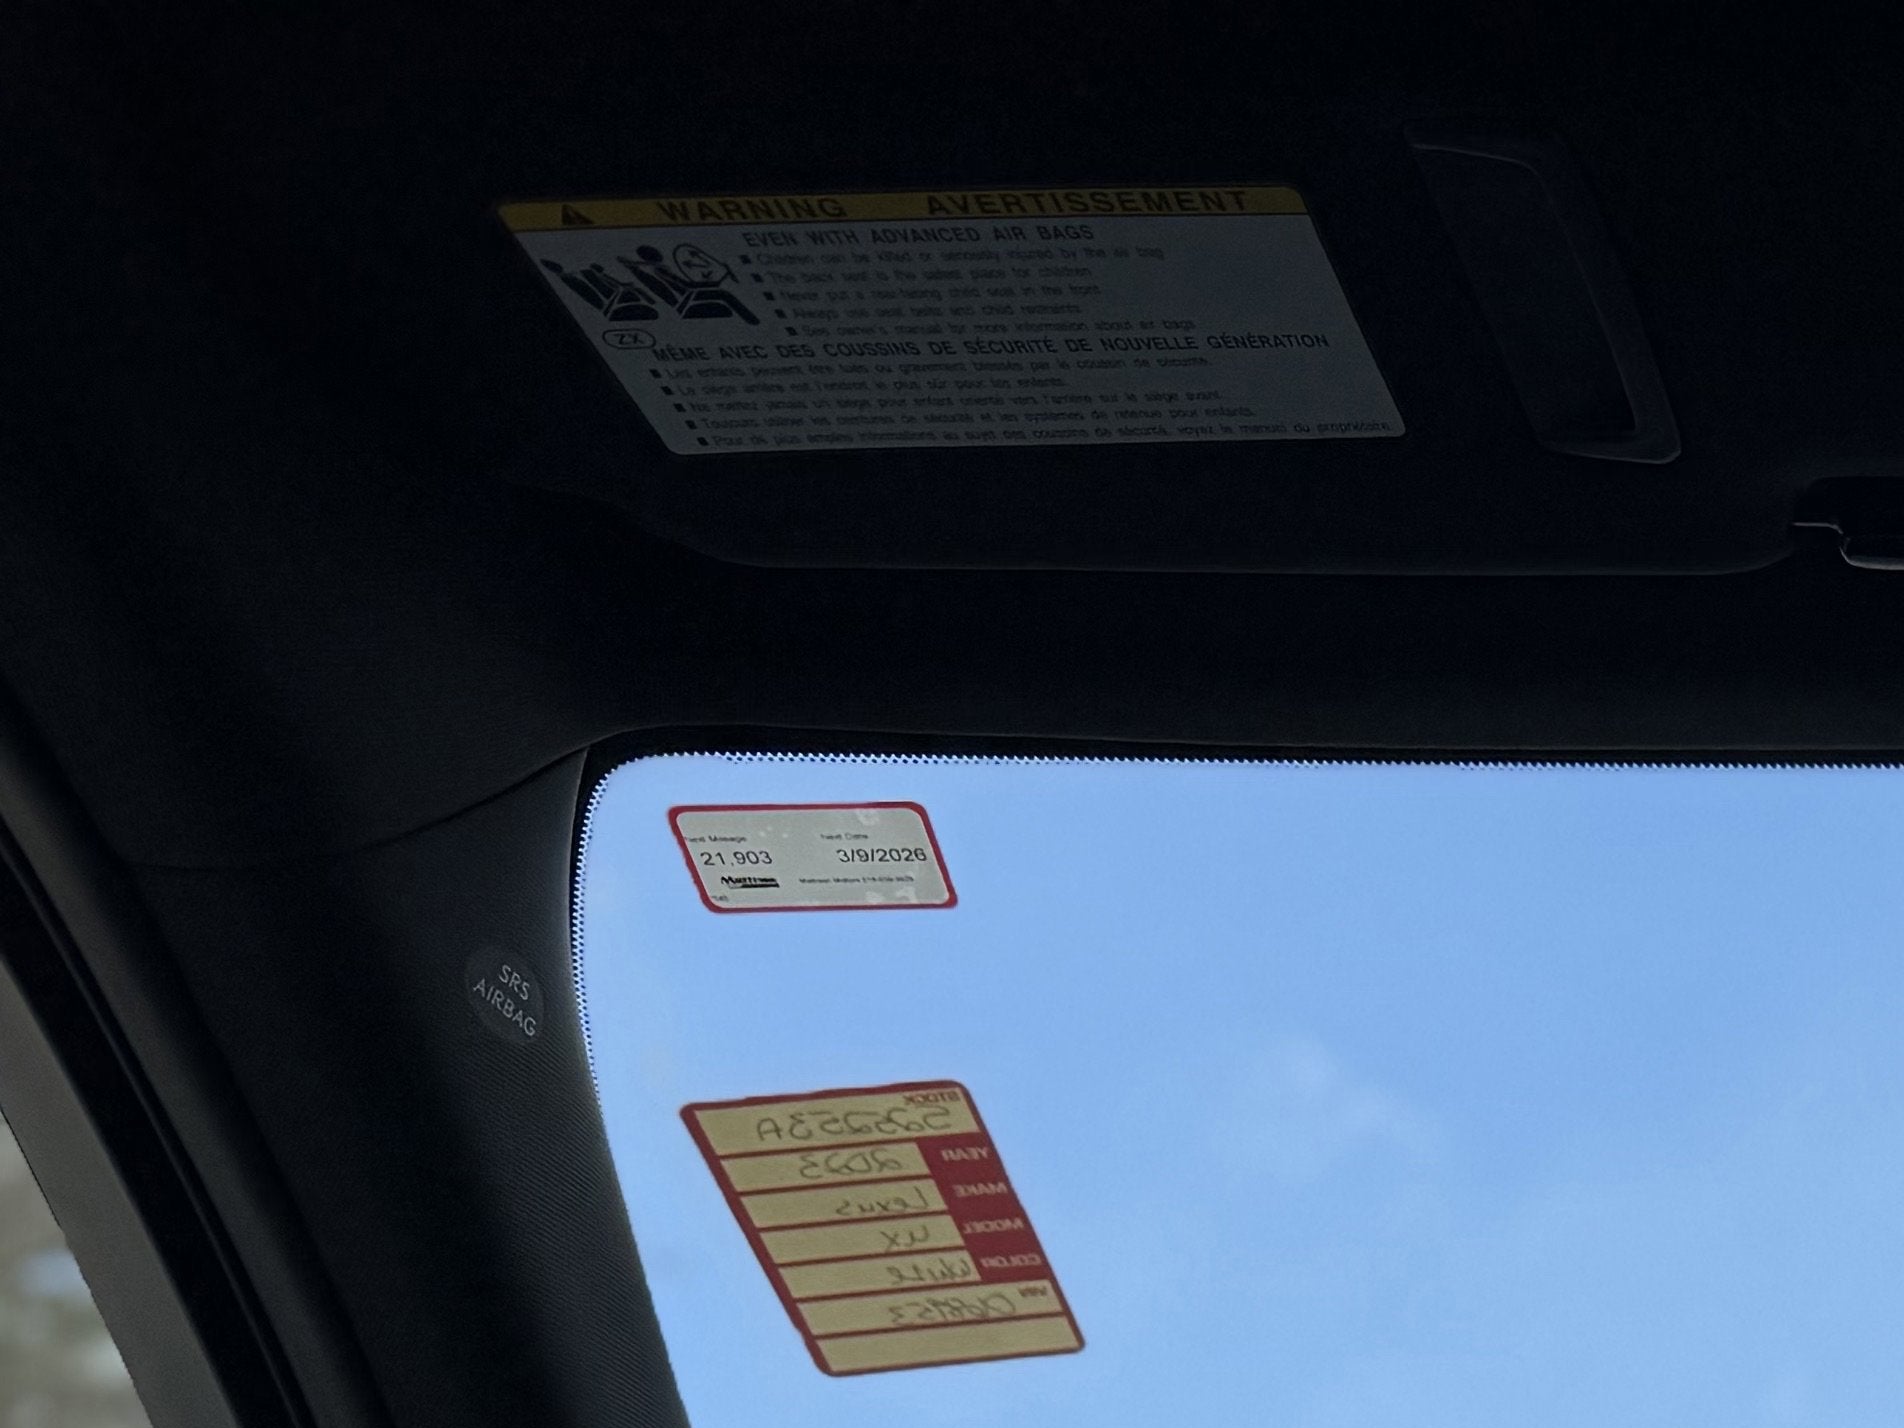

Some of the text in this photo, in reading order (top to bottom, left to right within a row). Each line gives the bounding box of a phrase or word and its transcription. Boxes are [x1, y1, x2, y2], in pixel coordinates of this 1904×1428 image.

[656, 189, 1248, 222] WARNING AVERTISSEMENT
[742, 223, 1095, 246] EVEN WITH ADVANCED AIR BAGS
[717, 345, 770, 359] AVEC
[776, 344, 817, 358] DES
[822, 342, 922, 357] COUSSINS
[928, 341, 957, 354] DE
[961, 334, 1058, 353] SÉCURITÉ
[1064, 337, 1093, 351] DE
[1100, 334, 1198, 350] NOUVELLE
[1204, 327, 1329, 347] GÉNÉRATION
[700, 850, 772, 866] 21,903
[836, 848, 928, 863] 3/9/2026
[498, 964, 530, 1000] SRS
[472, 978, 537, 1036] AIRBAG
